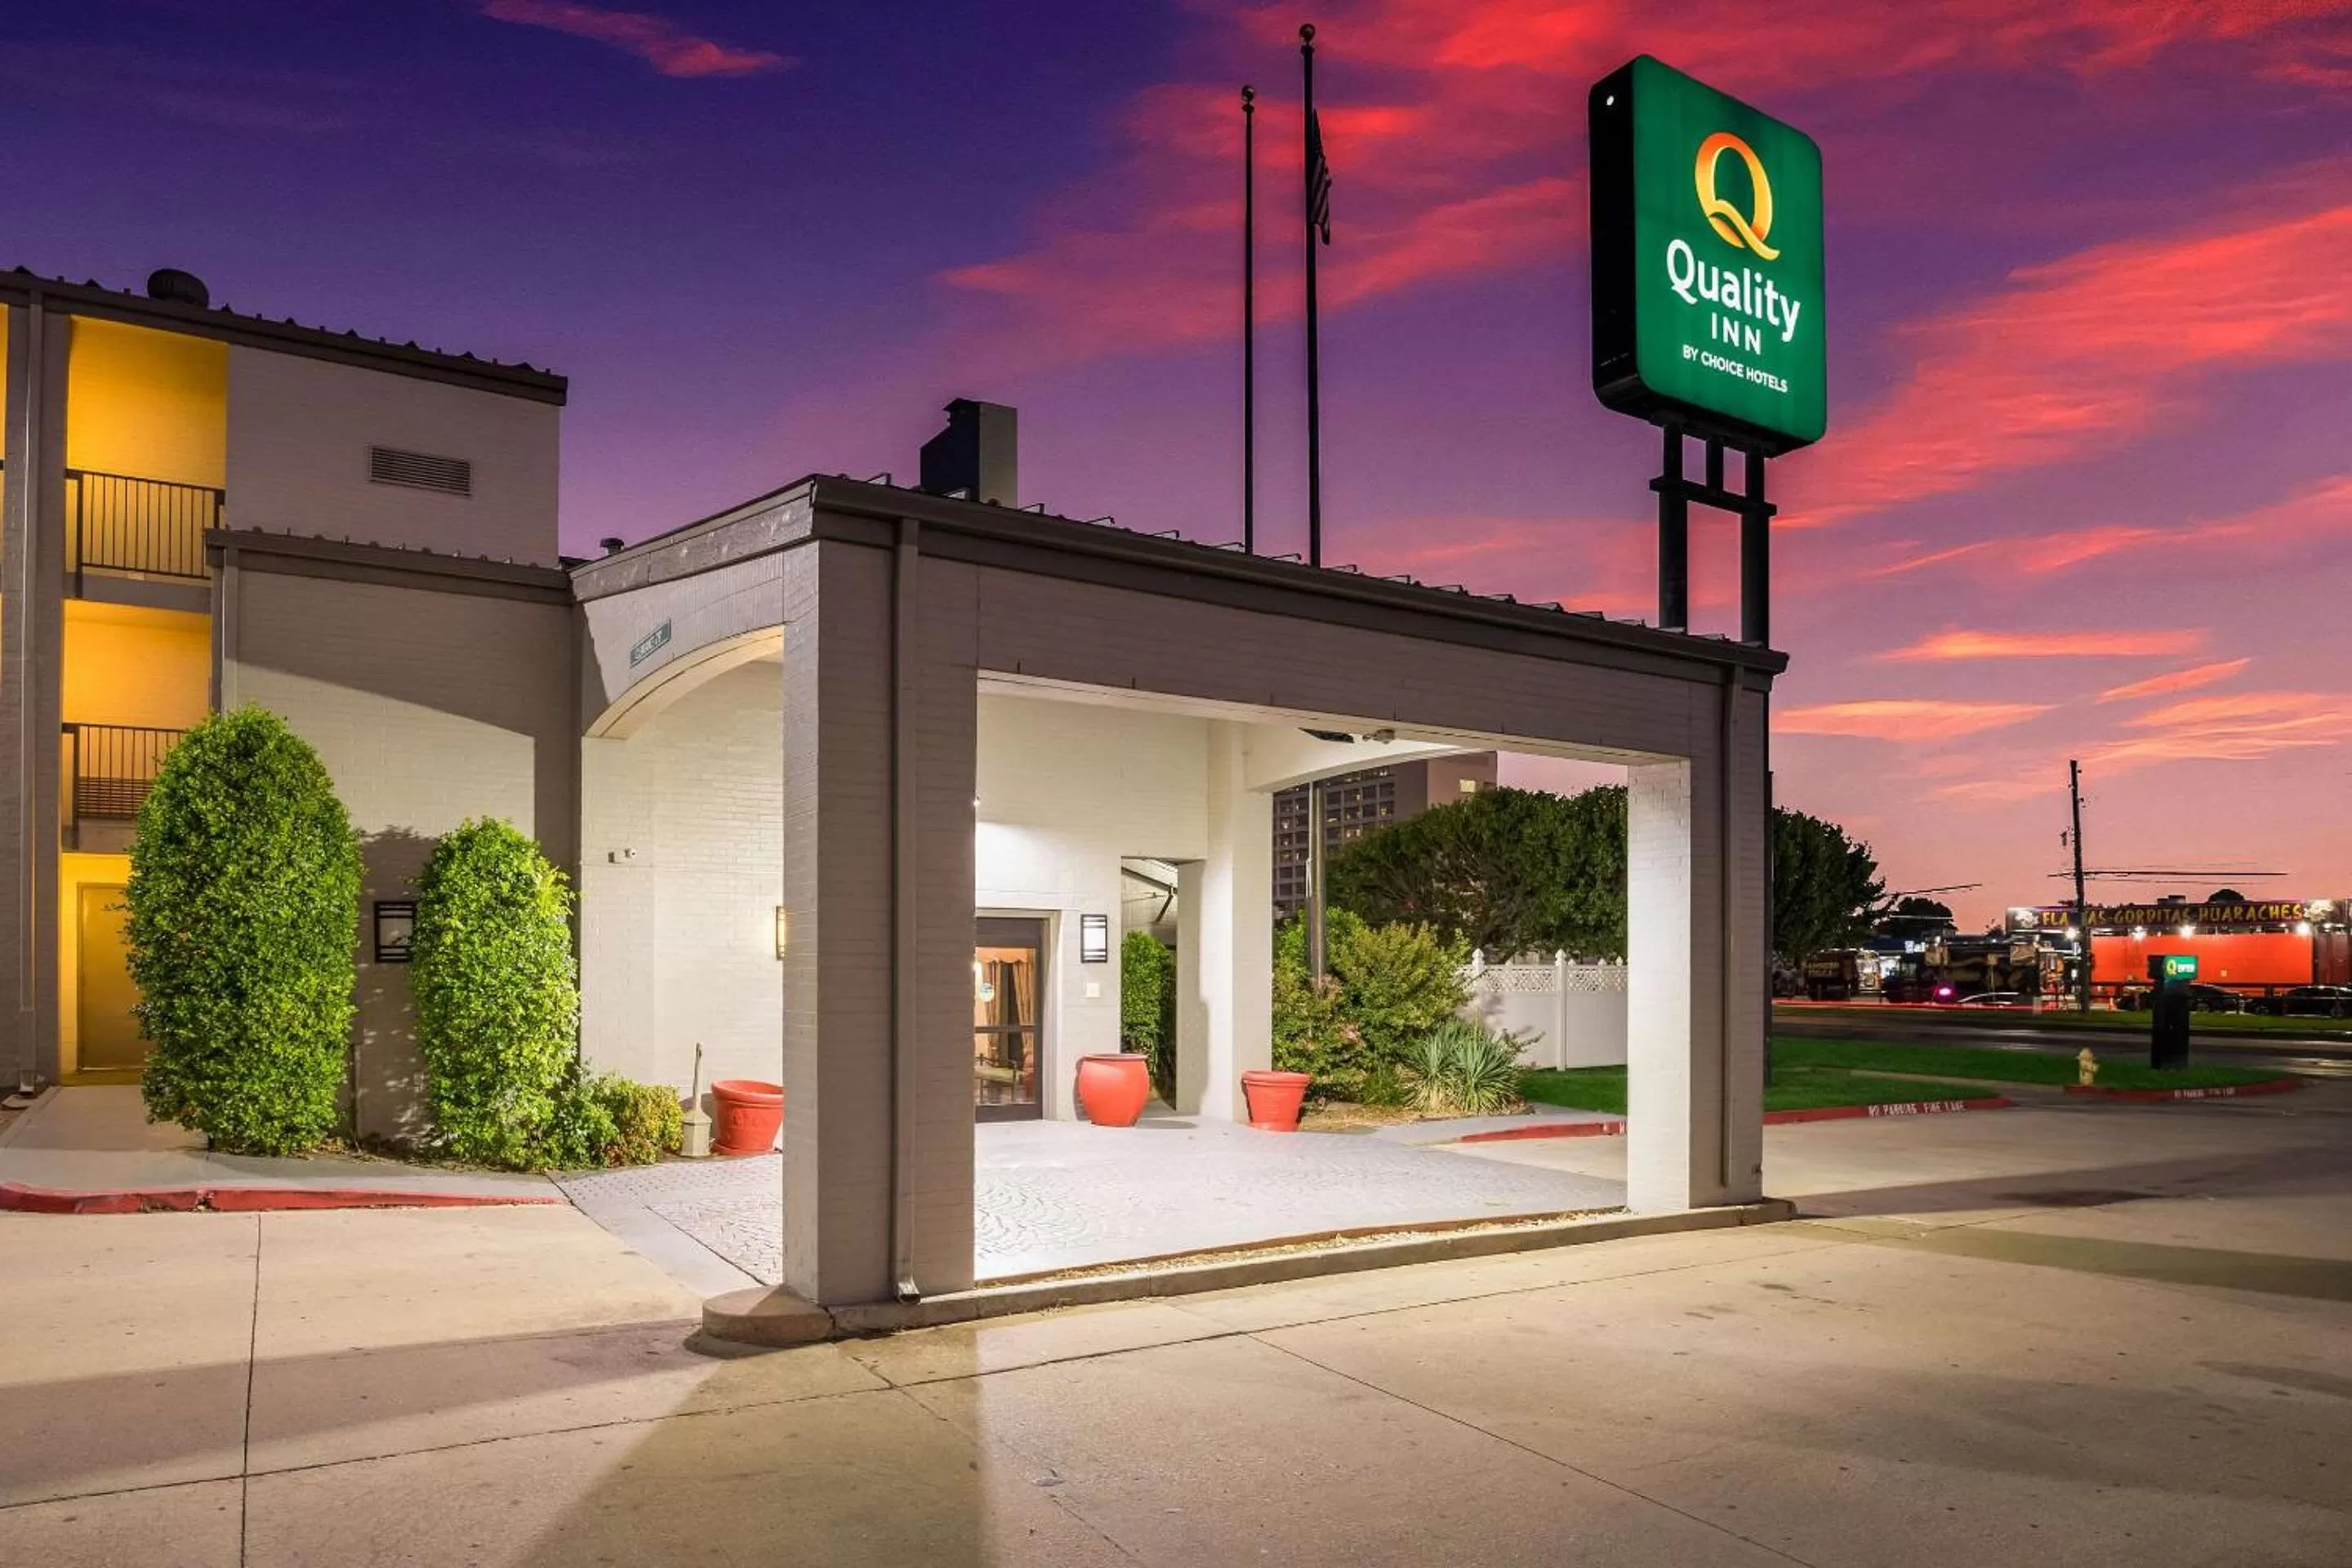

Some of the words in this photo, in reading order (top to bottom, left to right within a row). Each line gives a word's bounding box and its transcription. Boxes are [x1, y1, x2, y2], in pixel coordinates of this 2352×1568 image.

[1694, 131, 1780, 261] Q
[1666, 238, 1801, 342] Quality
[1711, 312, 1762, 355] INN
[1682, 344, 1699, 362] BY
[1700, 350, 1744, 377] CHOICE
[1746, 367, 1788, 393] HOTELS
[2198, 903, 2303, 922] HUARACHES
